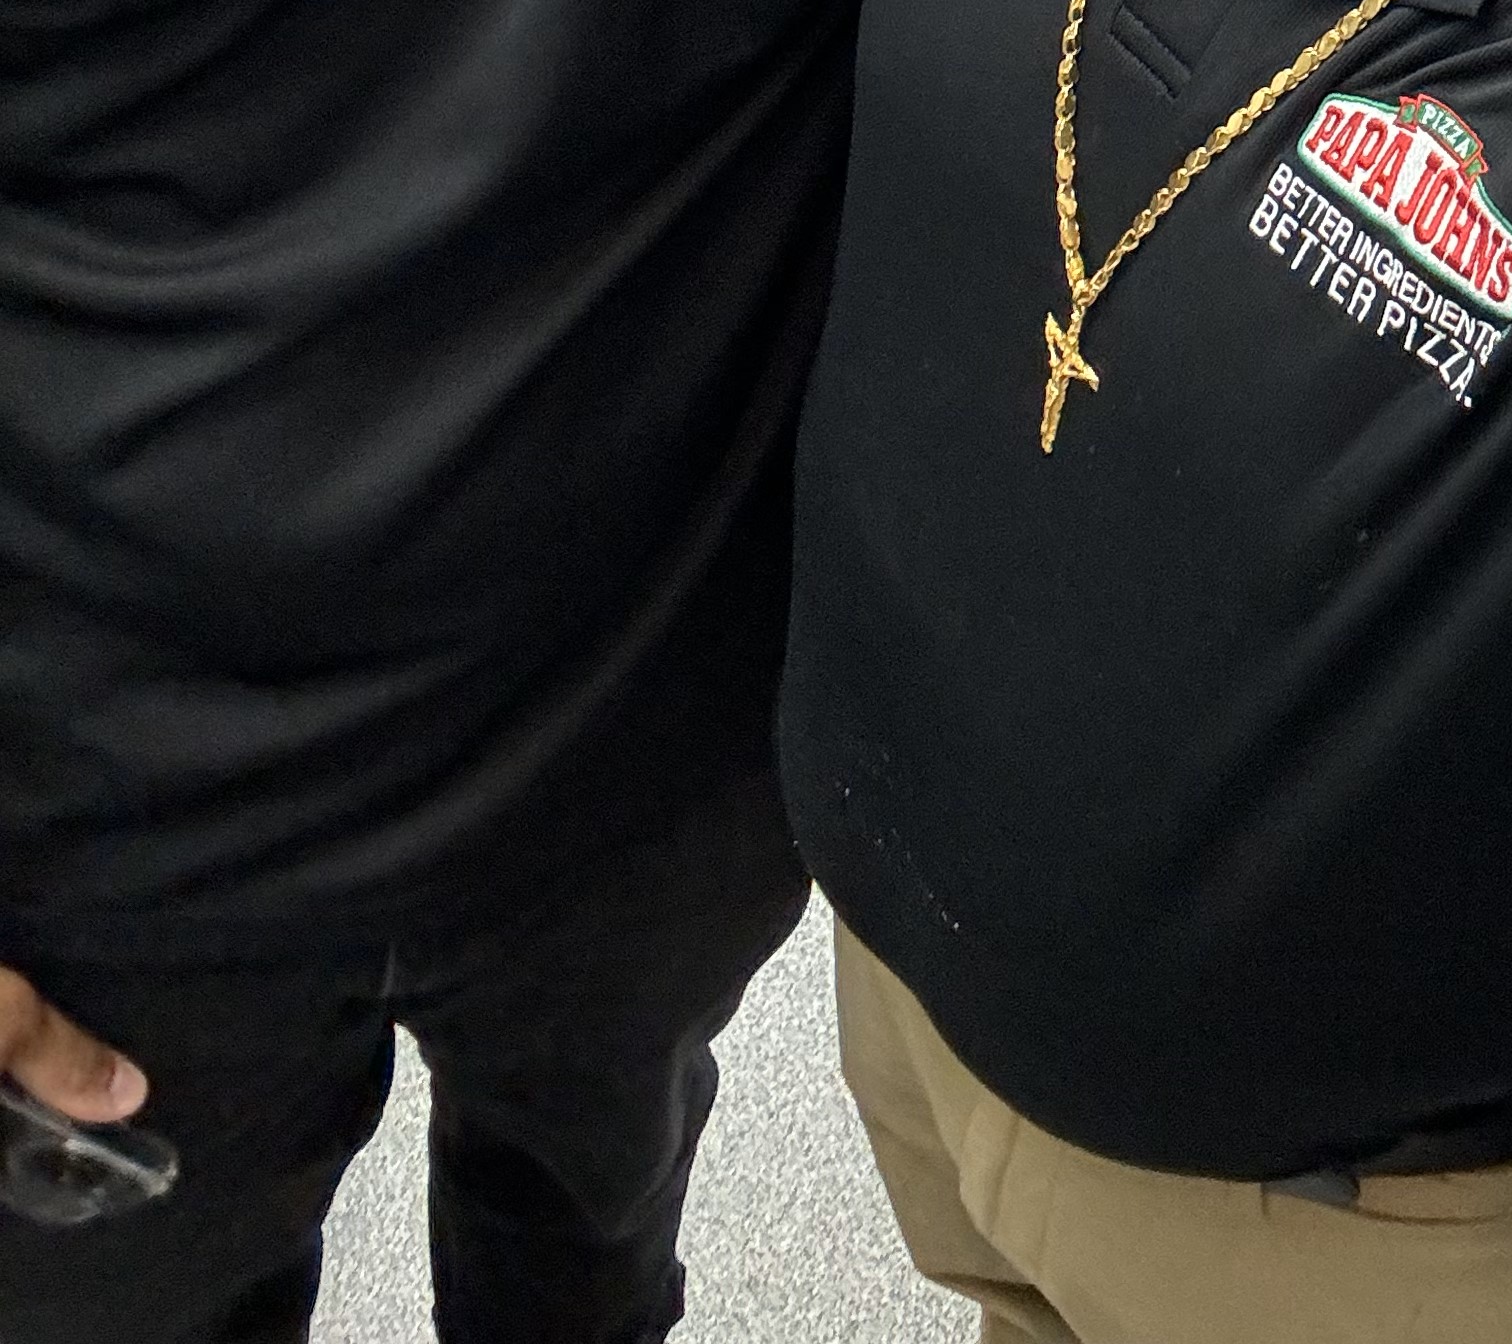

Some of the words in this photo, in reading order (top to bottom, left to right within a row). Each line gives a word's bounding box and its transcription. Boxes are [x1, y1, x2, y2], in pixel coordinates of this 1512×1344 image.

[1304, 105, 1416, 210] PAPA
[1420, 100, 1470, 158] PIZZA
[1266, 162, 1353, 255] BETTER
[1247, 194, 1378, 324] BETTER
[1375, 302, 1474, 409] PIZZA.
